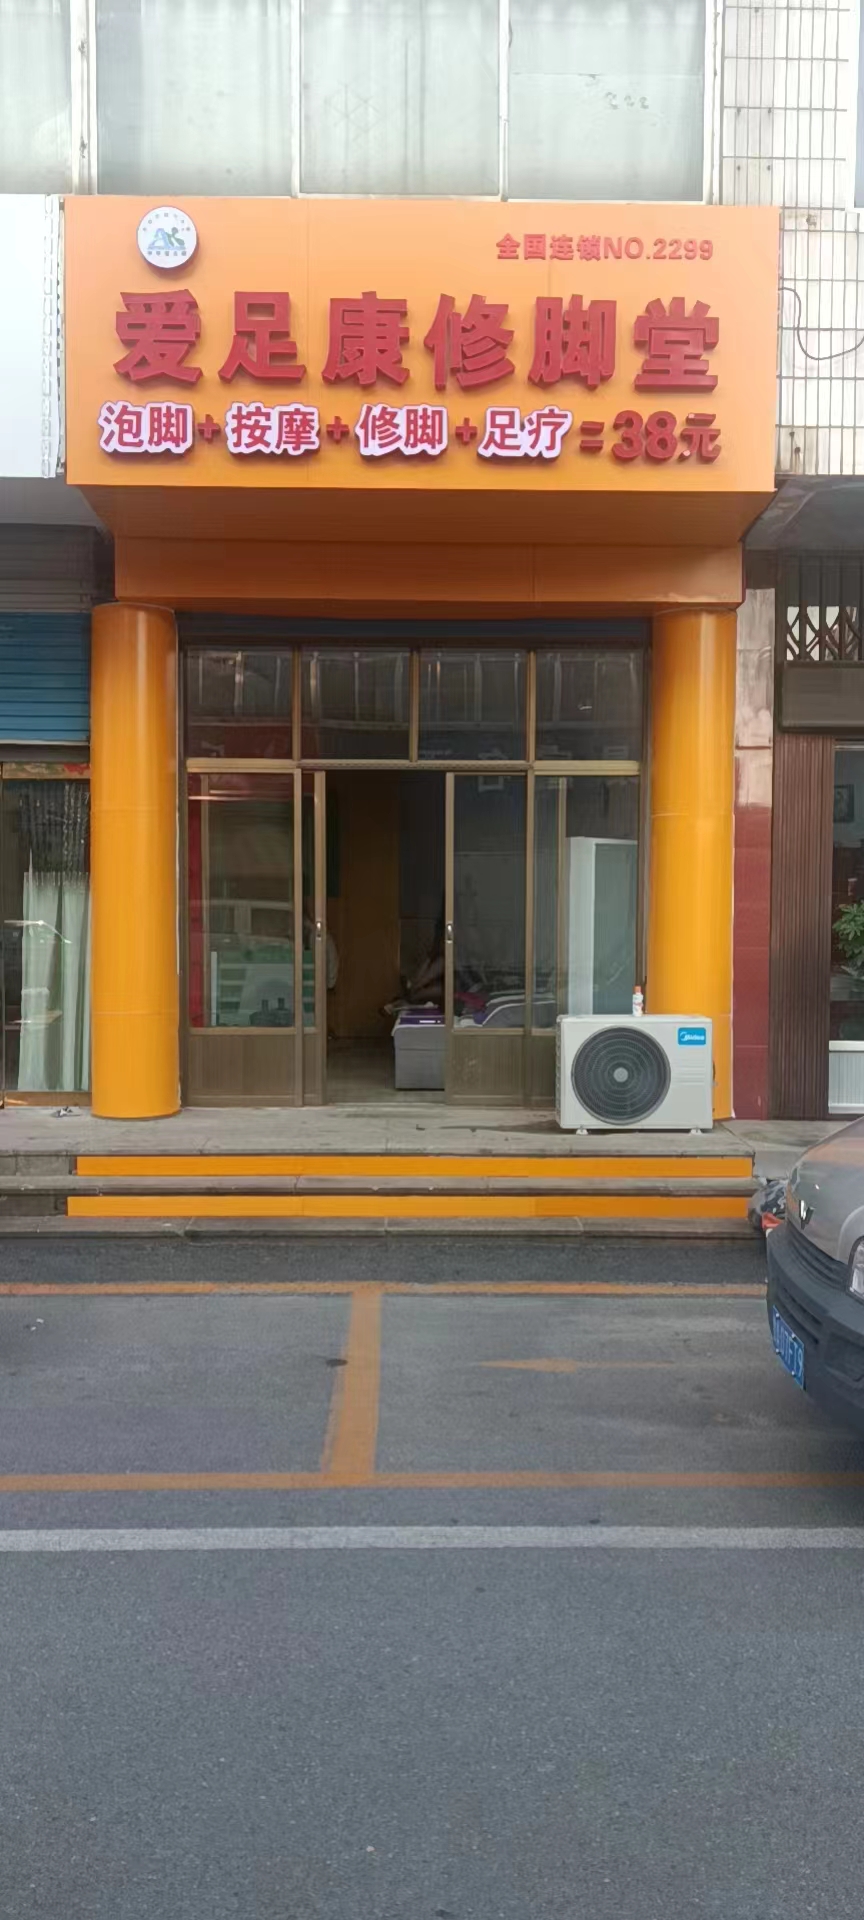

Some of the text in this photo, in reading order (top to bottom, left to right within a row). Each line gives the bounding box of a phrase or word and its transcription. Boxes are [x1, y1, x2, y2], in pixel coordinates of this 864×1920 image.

[496, 233, 714, 261] 全国连锁NO.2299
[113, 289, 720, 393] 爱足康修脚堂
